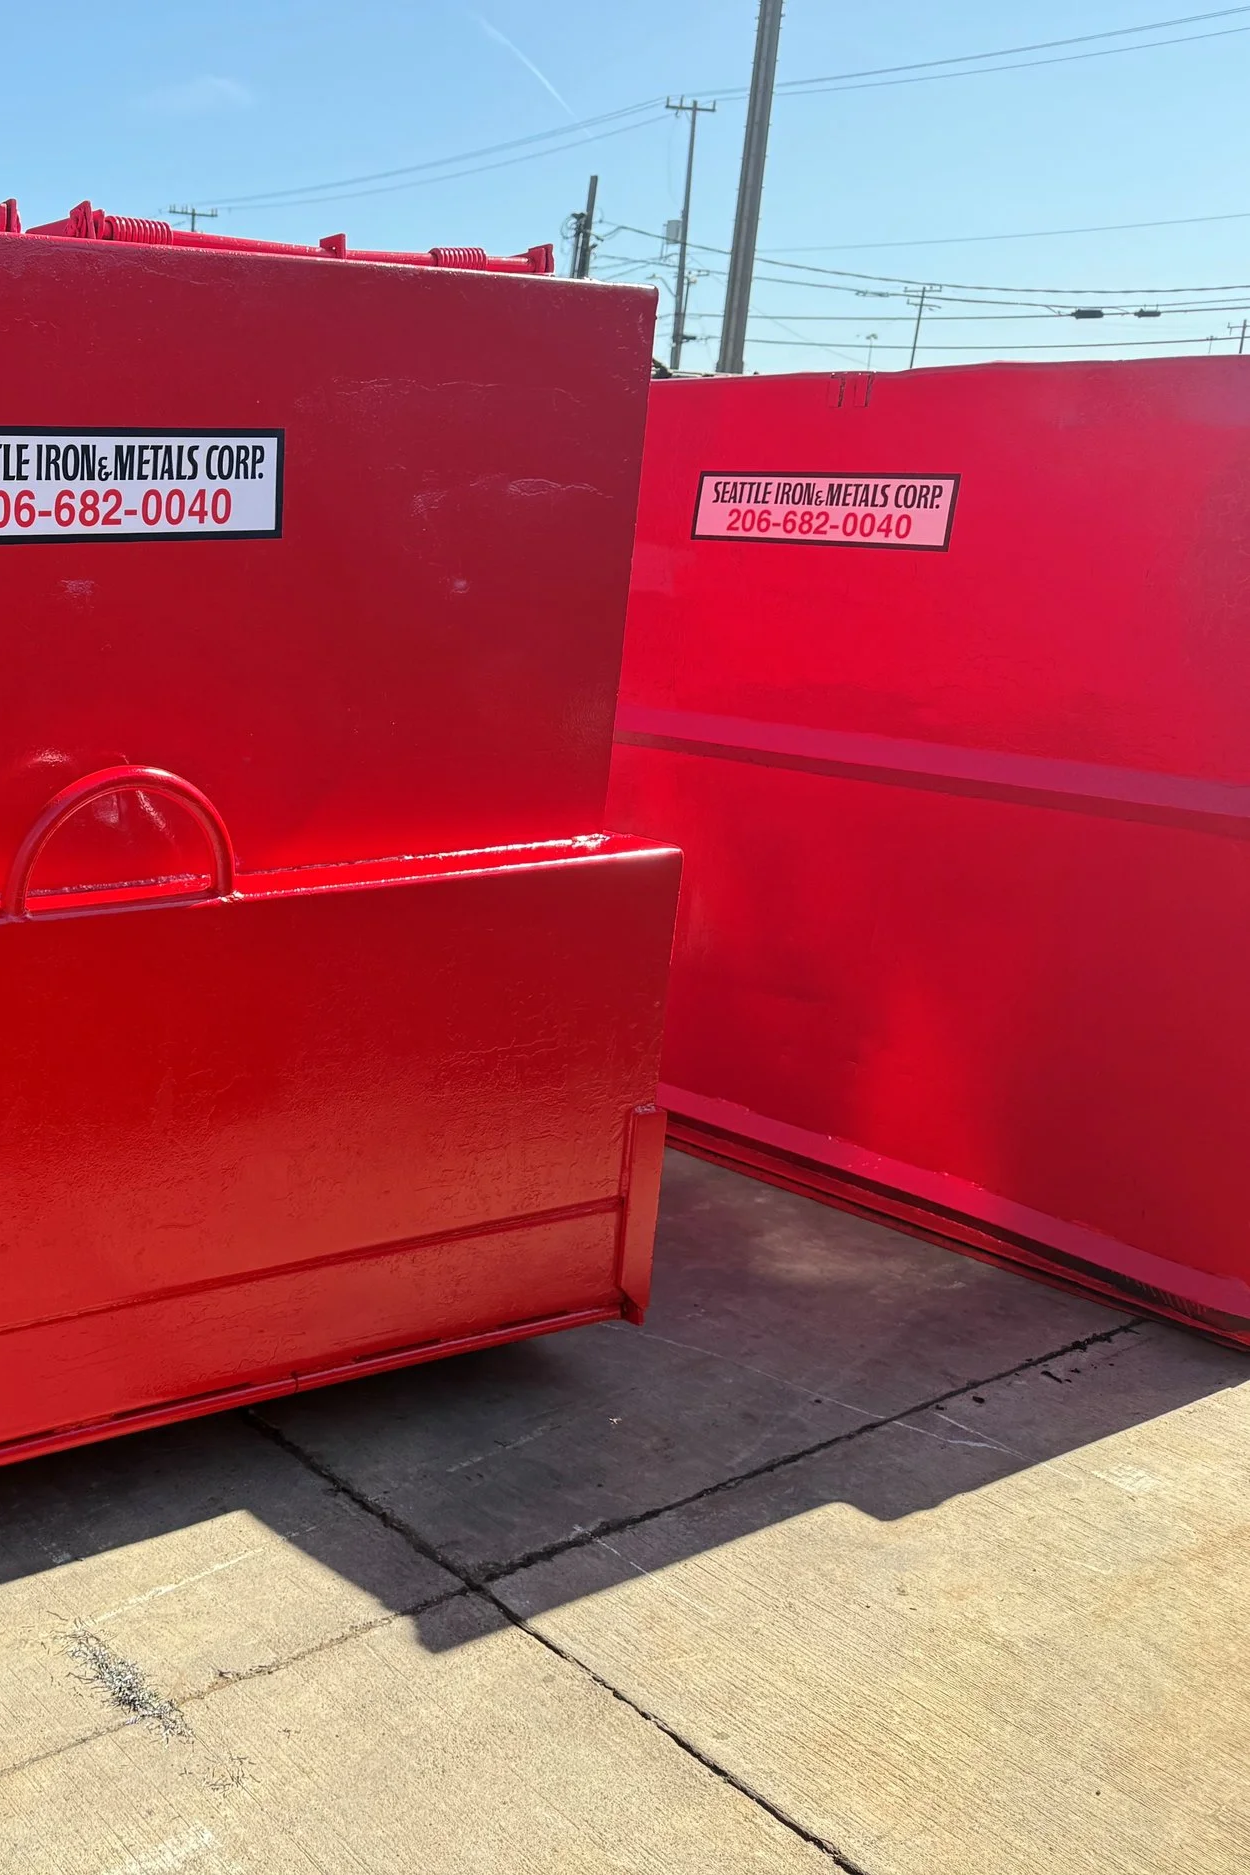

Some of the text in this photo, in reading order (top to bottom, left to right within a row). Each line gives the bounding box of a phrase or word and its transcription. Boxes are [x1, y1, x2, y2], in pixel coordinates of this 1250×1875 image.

[206, 445, 265, 480] CORP.
[712, 481, 773, 504] SEATTLE
[894, 484, 944, 509] CORP.
[726, 508, 912, 539] 206-682-0040
